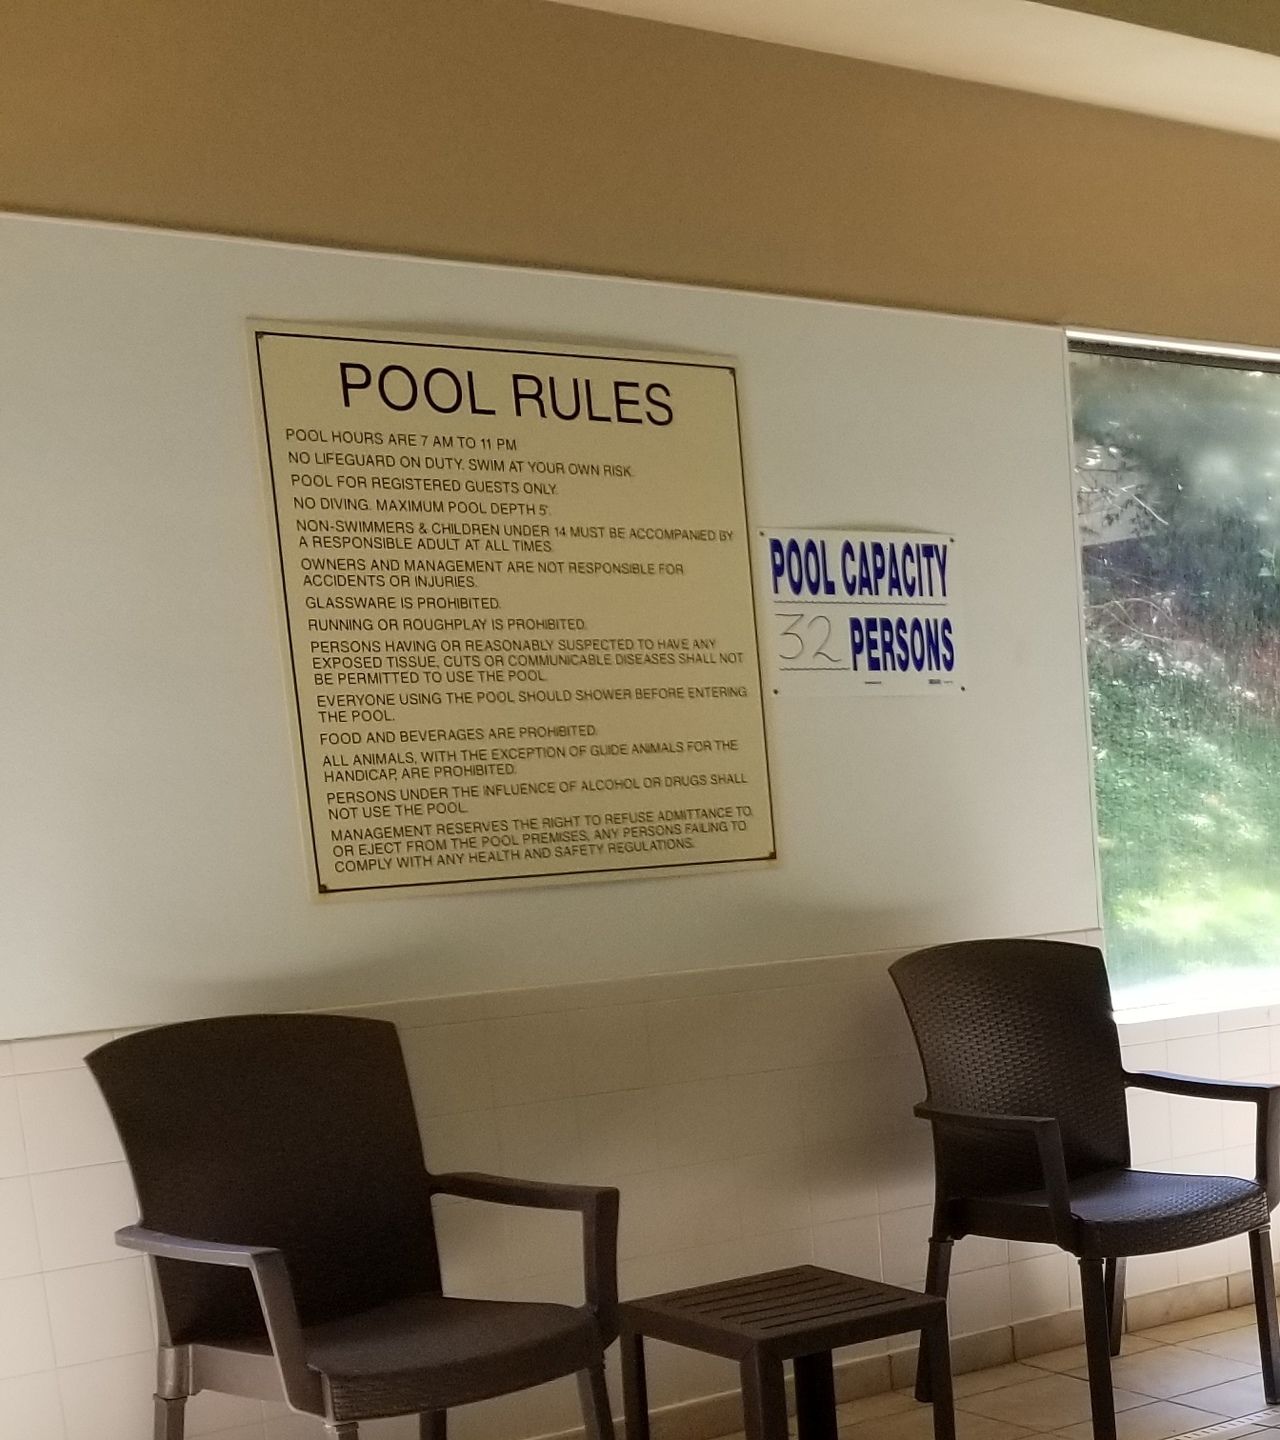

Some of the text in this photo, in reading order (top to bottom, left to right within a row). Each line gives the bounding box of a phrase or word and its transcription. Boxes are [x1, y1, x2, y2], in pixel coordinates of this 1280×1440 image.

[339, 362, 674, 427] POOL RULES
[285, 428, 517, 451] POOL HOURS ARE 7 AM TO 11 PM
[288, 451, 600, 476] NO LIFEGUARD ON DUTY. SWIM AT YOUR OWN
[290, 473, 334, 488] POOL
[336, 475, 368, 489] FOR
[371, 476, 461, 492] REGISTERED
[464, 479, 520, 494] GUESTS
[293, 496, 316, 510] NO
[375, 498, 445, 513] MAXIMUM
[447, 500, 487, 515] POOL
[490, 502, 536, 516] DEPTH
[296, 519, 626, 540] NON-SWIMMERS & CHILDREN UNDER 14 MUST BE
[299, 535, 510, 552] A RESPONSIBLE ADULT AT ALL
[300, 557, 684, 576] OWNERS AND MANAGEMENT ARE NOT FOR
[769, 538, 948, 598] POOL CAPACITY
[303, 574, 386, 588] ACCIDENTS
[389, 574, 411, 588] OR
[305, 596, 397, 610] GLASSWARE
[400, 596, 414, 610] IS
[307, 618, 374, 632] RUNNING
[377, 618, 400, 631] OR
[402, 618, 487, 631] ROUGHPLAY
[491, 618, 504, 631] IS
[310, 638, 655, 654] PERSONS HAVING OR REASONABLY TO
[774, 613, 955, 672] 32 PERSONS
[312, 652, 717, 670] EXPOSED TISSUE, CUTS OR SHALL
[313, 672, 334, 686] BE
[337, 671, 420, 685] PERMITTED
[422, 671, 443, 684] TO
[445, 670, 475, 683] USE
[477, 670, 505, 683] THE
[316, 688, 633, 708] EVERYONE USING THE POOL SHOULD SHOWER
[317, 709, 396, 723] THE POOL.
[319, 731, 362, 746] FOOD
[366, 730, 396, 744] AND
[399, 728, 485, 743] BEVERAGES
[488, 726, 516, 740] ARE
[322, 744, 587, 767] ALL ANIMALS, WITH THE EXCEPTION OF
[323, 767, 398, 783] HANDICAP,
[401, 766, 430, 780] ARE
[326, 773, 749, 805] PERSONS UNDER THE OF SHALL
[328, 806, 359, 820] NOT
[362, 805, 392, 819] USE
[394, 803, 424, 816] THE
[330, 814, 602, 842] MANAGEMENT RESERVES THE RIGHT TO
[332, 828, 618, 858] OR EJECT FROM THE POOL ANY
[334, 847, 552, 874] COMPLY WITH ANY HEALTH AND
